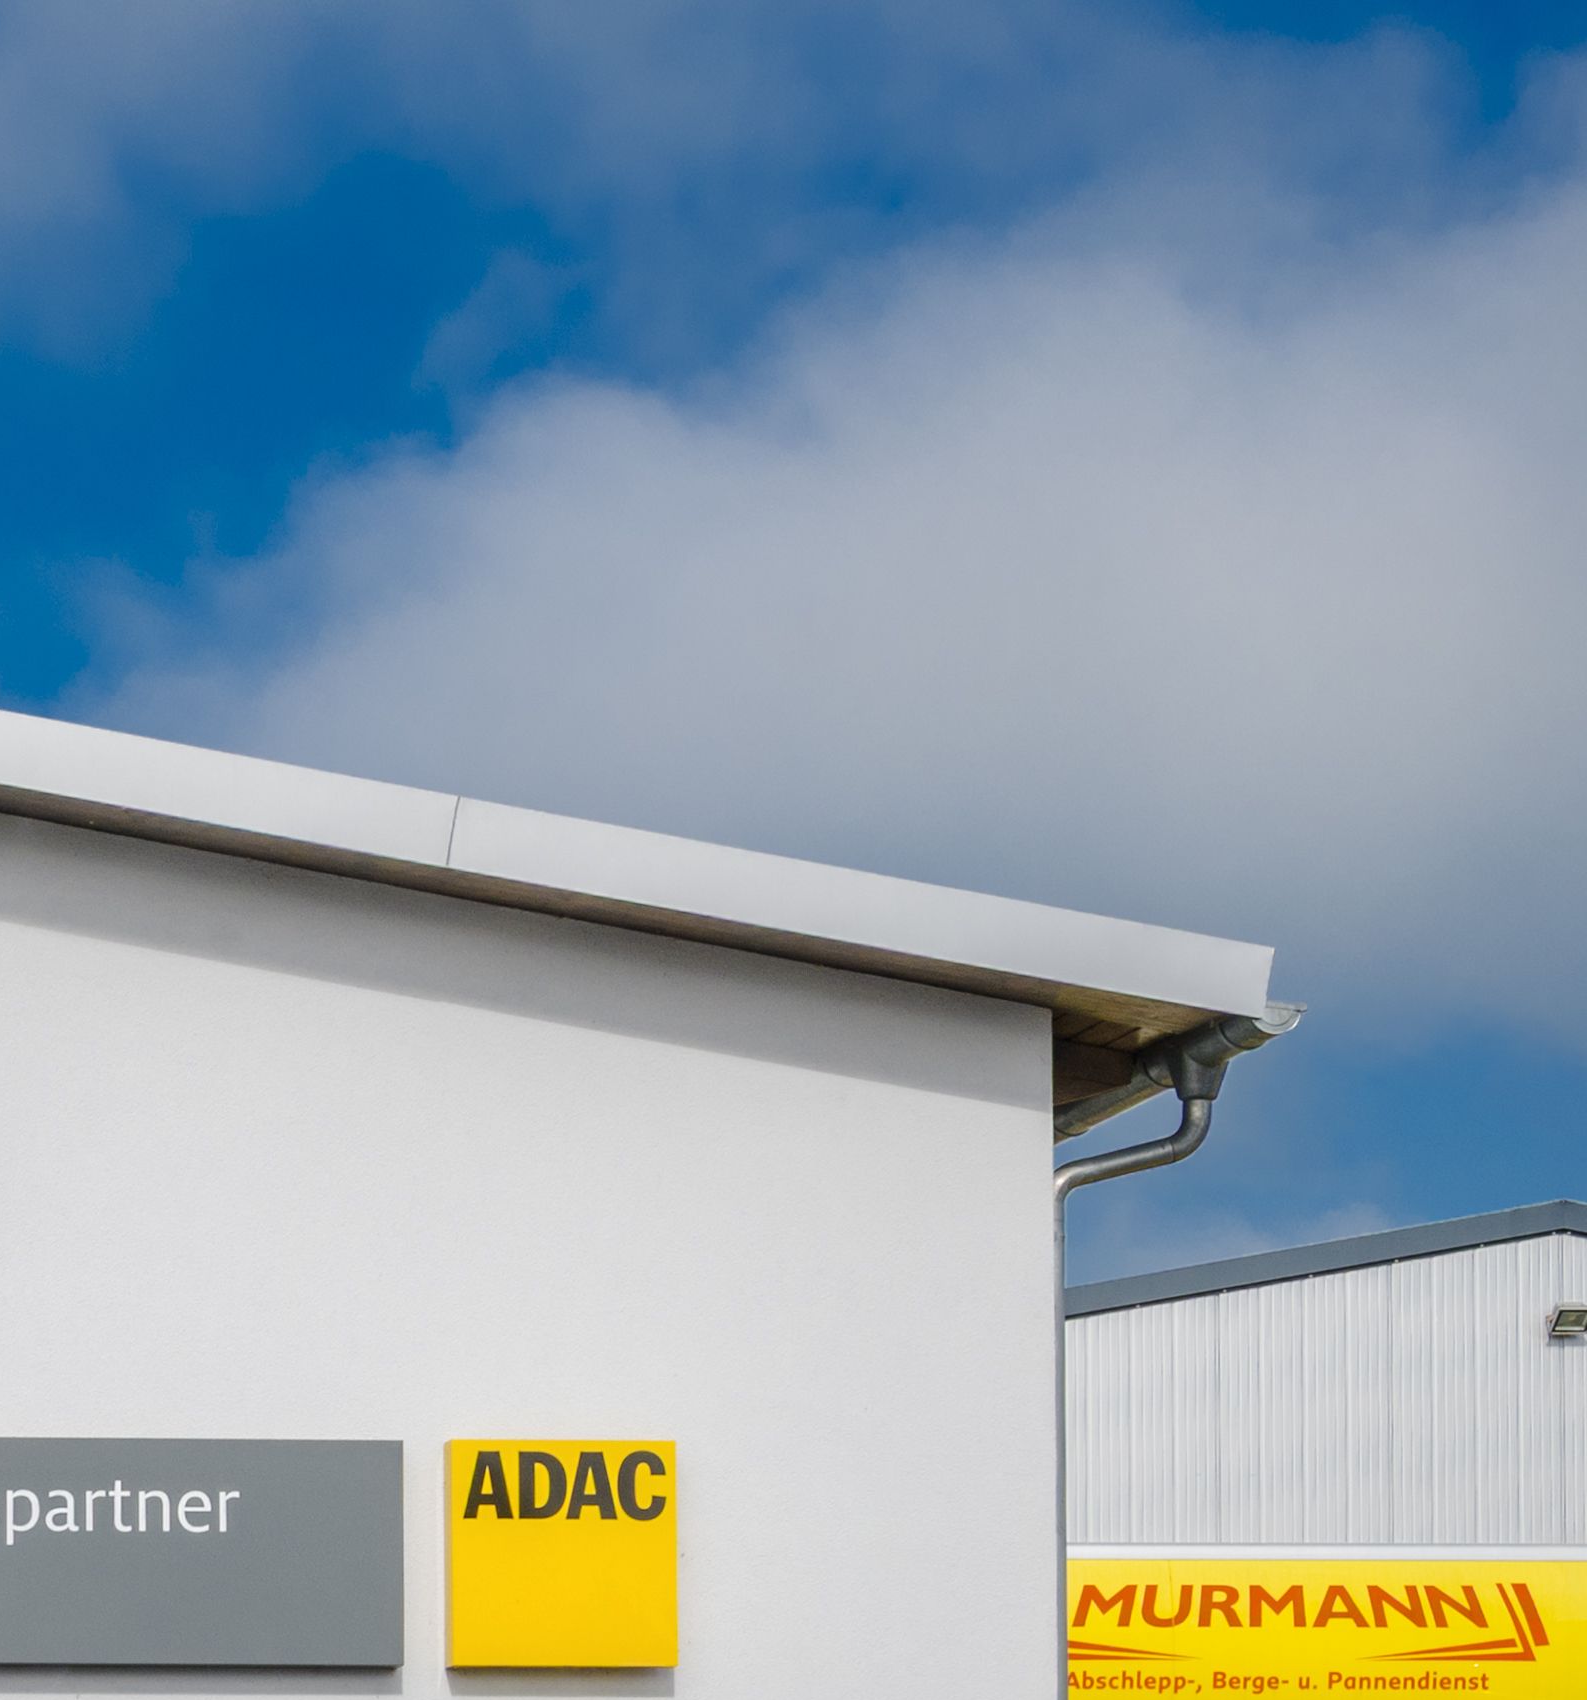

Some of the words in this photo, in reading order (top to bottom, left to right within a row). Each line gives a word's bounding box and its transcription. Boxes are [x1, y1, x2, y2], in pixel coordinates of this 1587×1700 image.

[464, 1452, 667, 1522] ADAC
[1071, 1584, 1489, 1628] MURMANN
[1067, 1671, 1202, 1694] Abschlepp-,
[1212, 1671, 1289, 1694] Berge-
[1298, 1676, 1318, 1690] u.
[1328, 1671, 1489, 1690] Pannendienst
